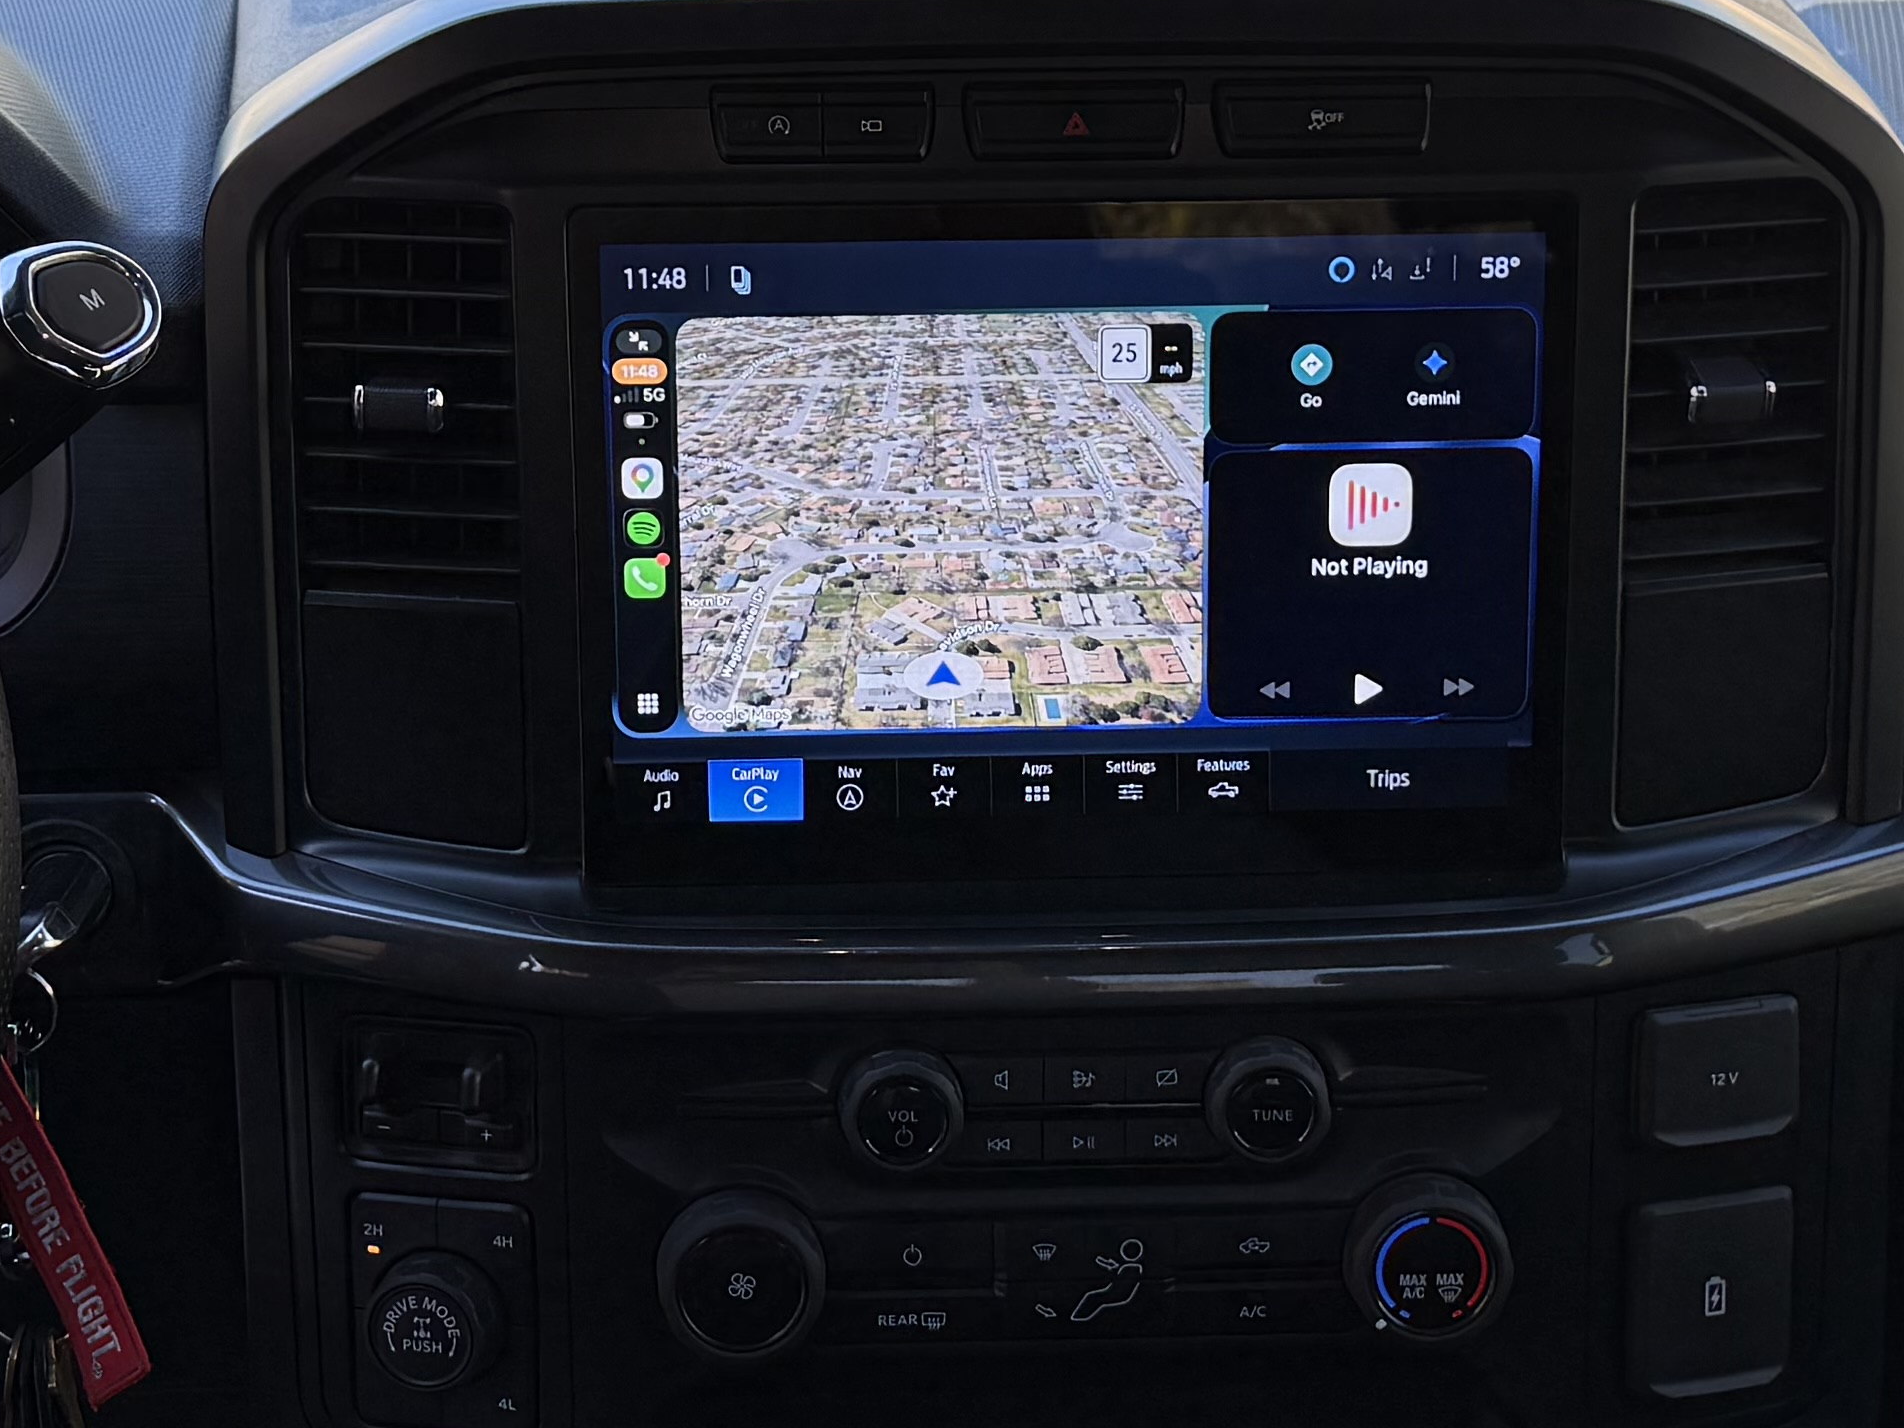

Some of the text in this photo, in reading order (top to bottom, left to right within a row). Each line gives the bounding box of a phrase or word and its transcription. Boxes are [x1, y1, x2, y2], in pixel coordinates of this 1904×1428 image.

[1324, 112, 1345, 123] OFF
[1480, 256, 1521, 279] 58°
[624, 267, 686, 290] 11:48
[79, 287, 107, 312] M
[1111, 342, 1138, 363] 25
[620, 365, 658, 377] 11:48
[1159, 362, 1183, 378] mph
[643, 387, 666, 403] 5G
[1300, 393, 1322, 408] Go
[1406, 390, 1461, 406] Gemini
[1311, 556, 1428, 578] Not Playing
[716, 595, 733, 607] Dr
[721, 586, 767, 677] Wagonwheel Dr
[938, 619, 1000, 651] avidson Dr
[689, 705, 792, 723] Google Maps
[838, 765, 862, 779] Nav
[932, 764, 955, 777] Fav
[1022, 762, 1053, 777] Apps
[1105, 759, 1156, 775] Settings
[1197, 759, 1250, 773] Features
[644, 769, 679, 783] Audio
[732, 767, 779, 782] CarPlay
[1366, 769, 1411, 790] Trips
[1710, 1071, 1739, 1086] 12 V
[887, 1110, 919, 1123] VOL
[1252, 1108, 1293, 1122] TUNE
[363, 1223, 384, 1237] 2H
[493, 1236, 514, 1249] 4H
[1399, 1273, 1427, 1286] MAX
[1436, 1273, 1464, 1286] MAX
[1402, 1287, 1425, 1300] A/C
[55, 1253, 122, 1364] FLIGHT
[1239, 1305, 1267, 1319] A/C
[383, 1296, 462, 1338] DRIVE MODE
[877, 1312, 918, 1327] REAR
[403, 1338, 443, 1354] PUSH
[498, 1397, 518, 1412] 4L
